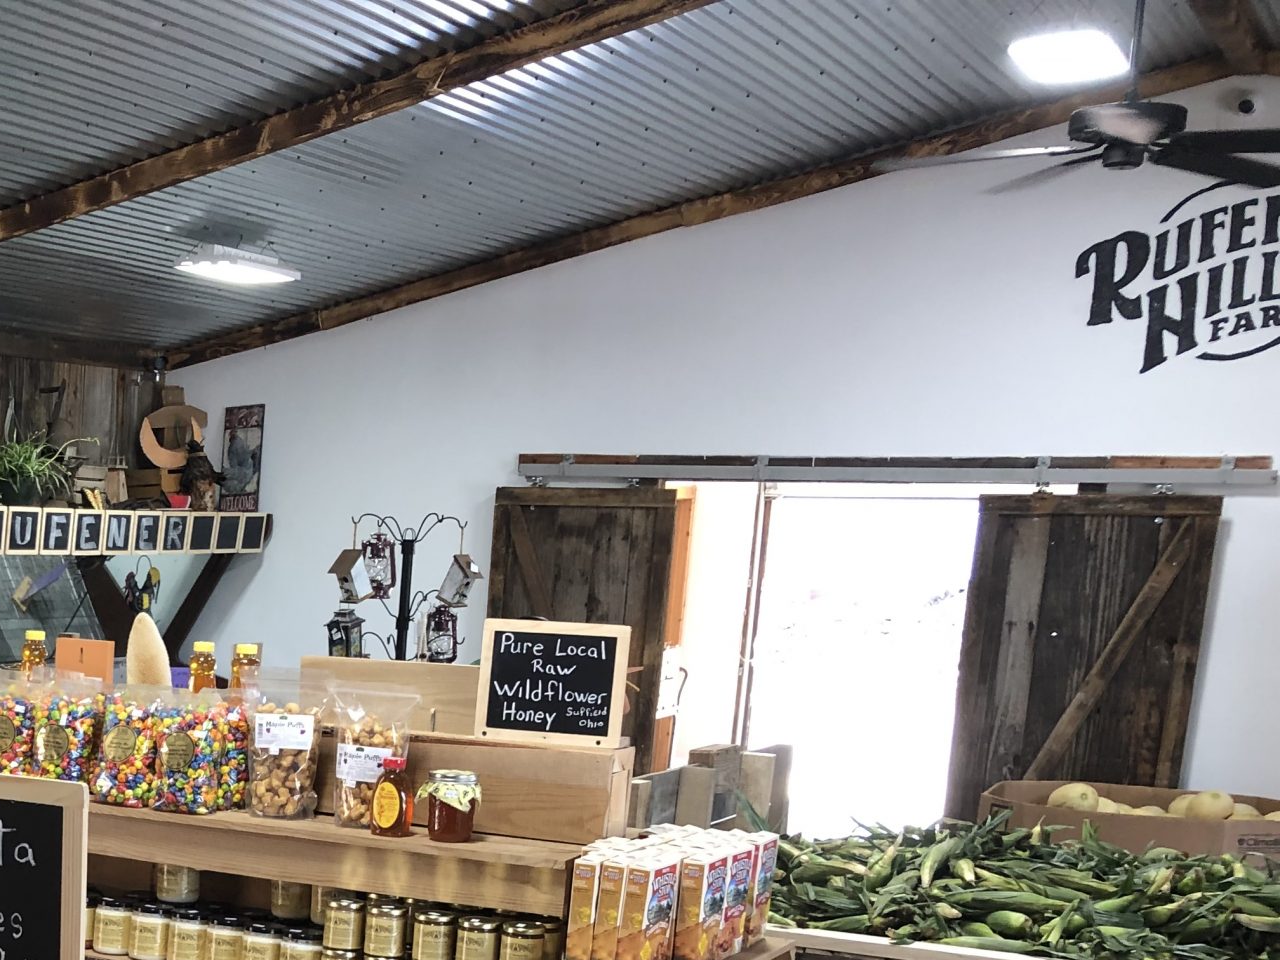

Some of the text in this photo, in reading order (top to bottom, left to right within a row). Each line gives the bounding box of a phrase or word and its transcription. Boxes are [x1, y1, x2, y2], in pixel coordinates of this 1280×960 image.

[500, 632, 606, 660] Pure Local
[530, 658, 577, 675] Raw
[493, 678, 608, 705] Wildflower
[502, 701, 557, 731] Honey
[578, 719, 604, 728] Ohio
